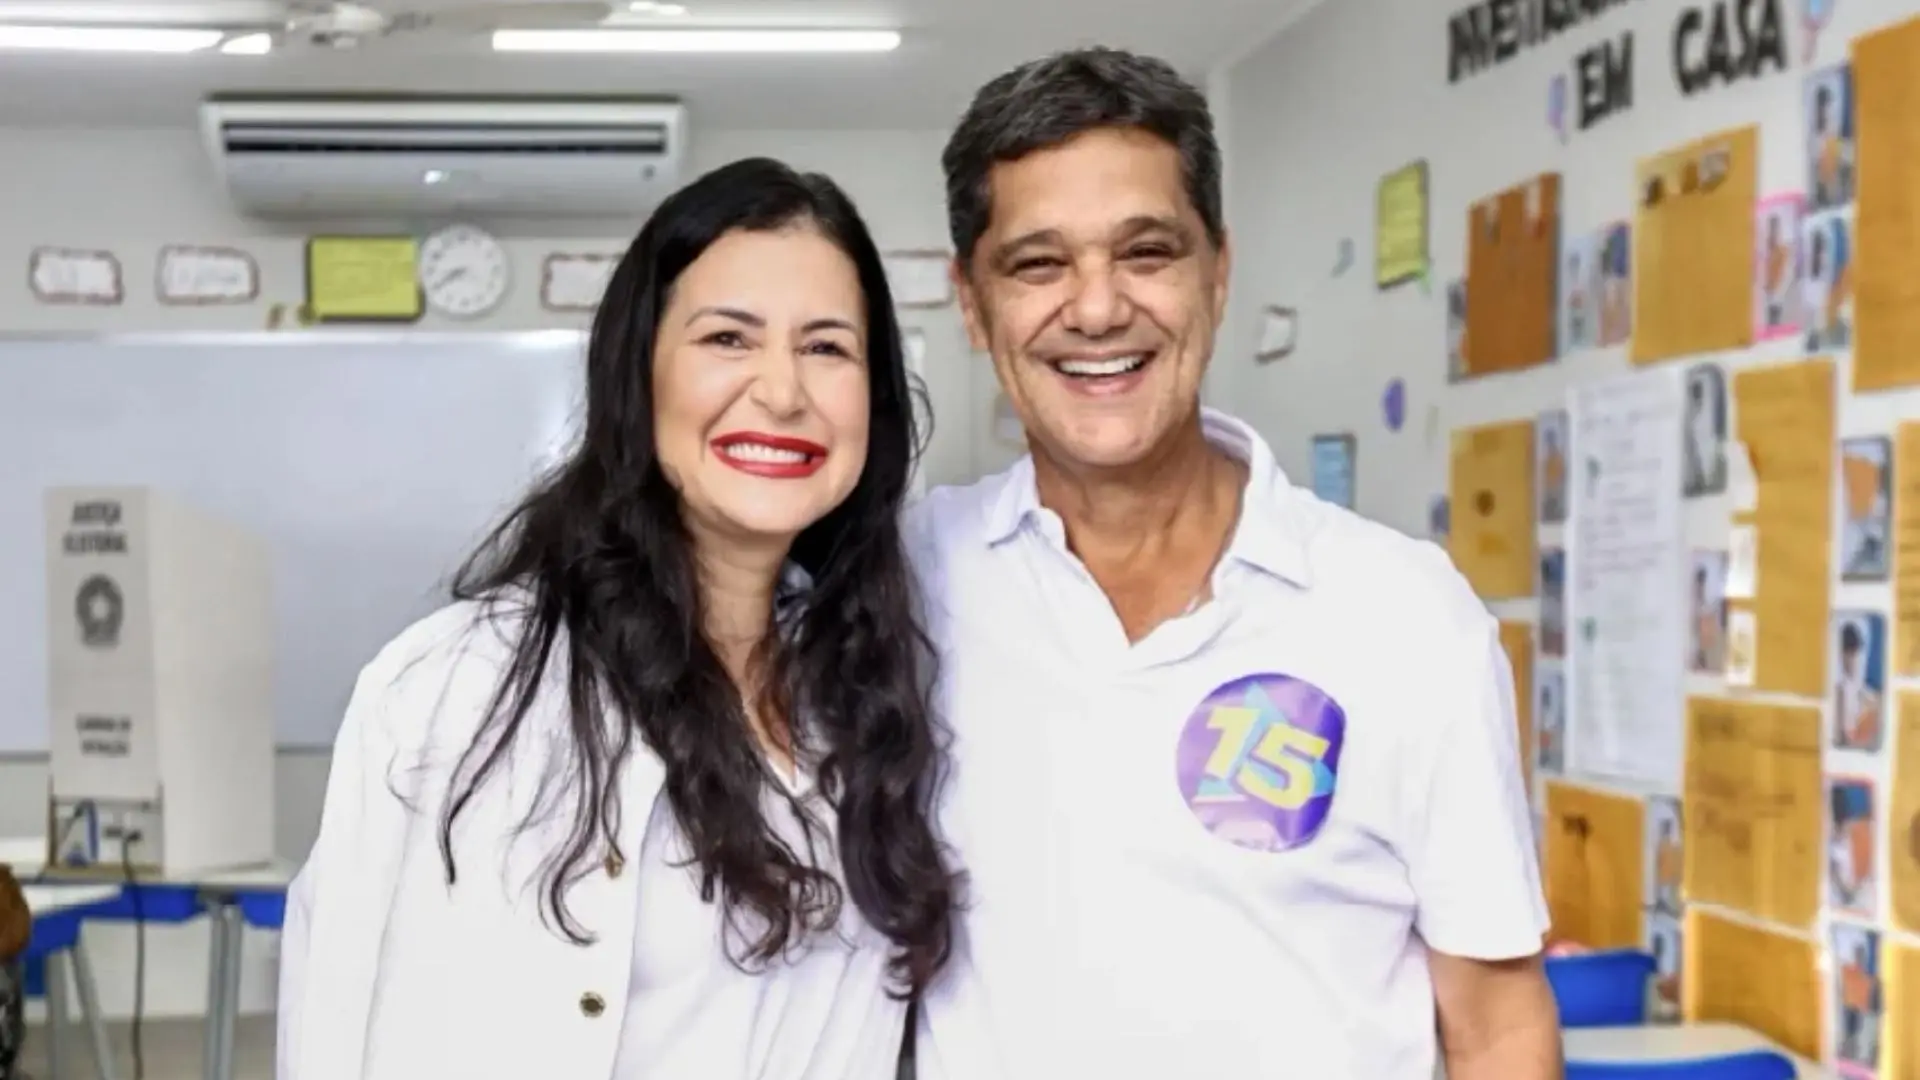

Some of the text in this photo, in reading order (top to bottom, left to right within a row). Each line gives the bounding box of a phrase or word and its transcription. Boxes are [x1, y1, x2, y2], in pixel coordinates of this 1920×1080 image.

[1577, 0, 1788, 130] EM CASA
[1204, 705, 1331, 811] 15
